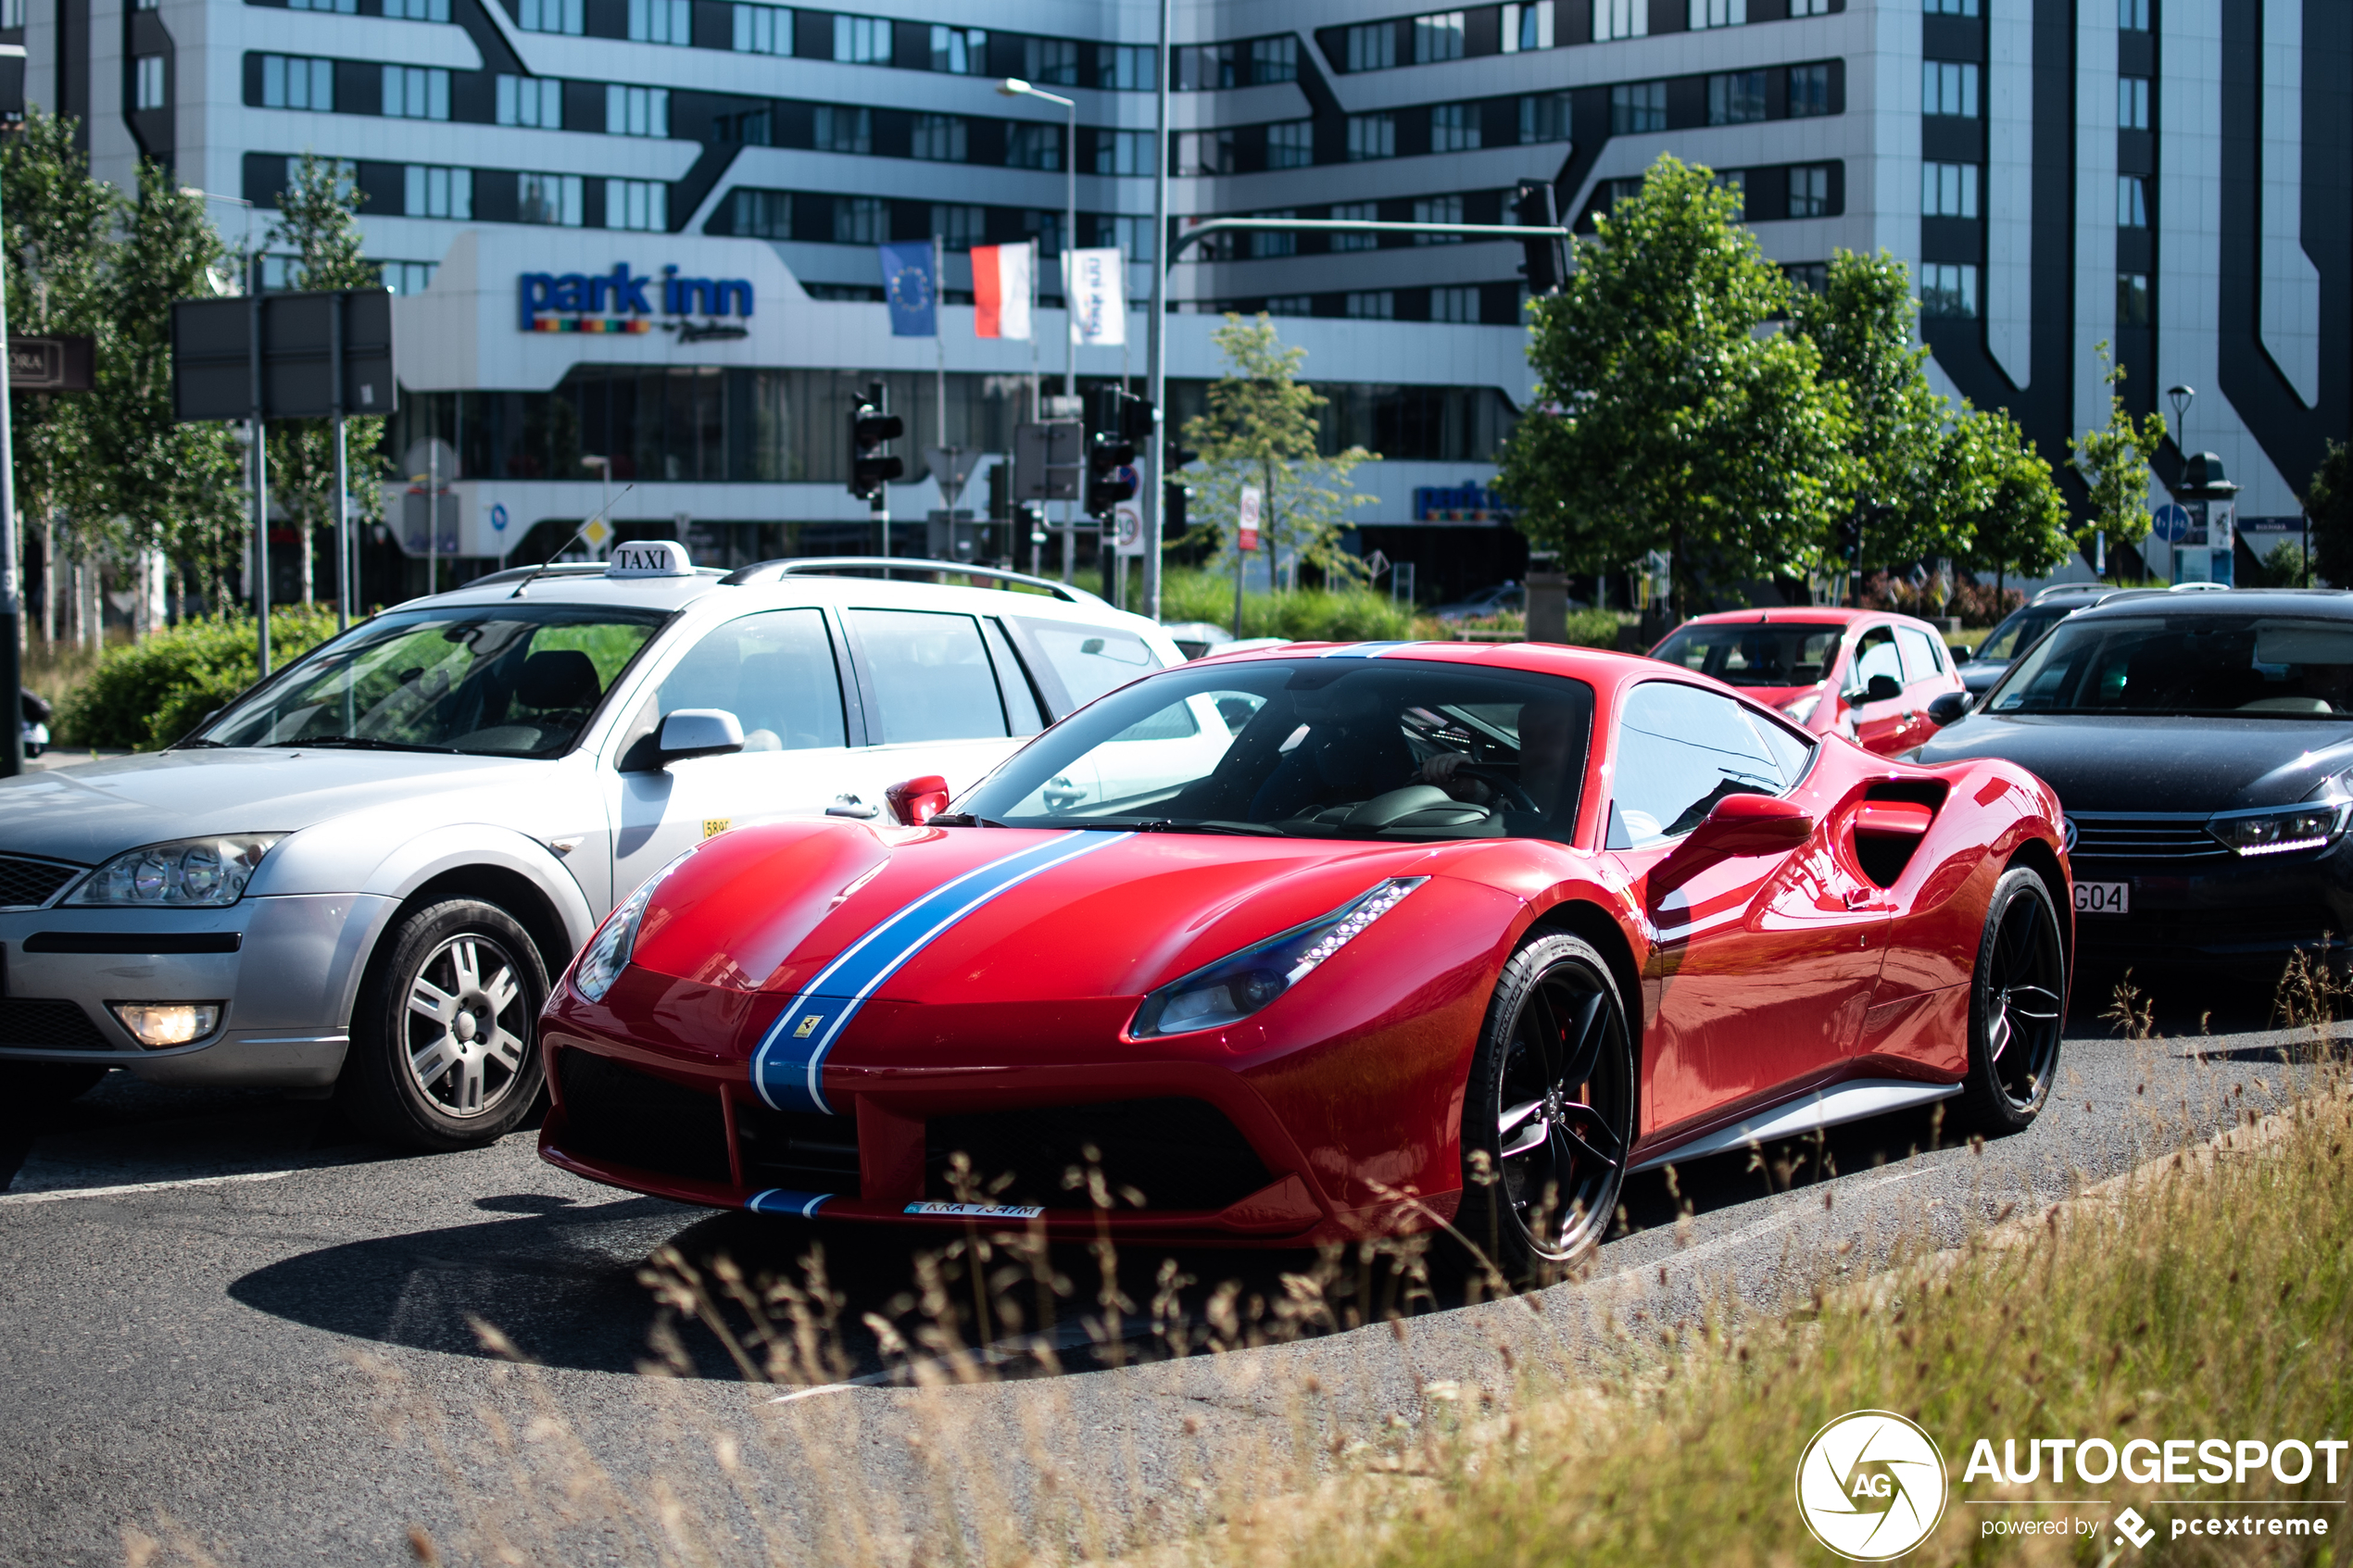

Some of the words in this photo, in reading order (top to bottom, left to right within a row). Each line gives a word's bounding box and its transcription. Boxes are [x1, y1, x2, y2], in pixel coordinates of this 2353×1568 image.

[518, 263, 652, 332] park
[663, 264, 754, 317] inn
[617, 549, 666, 570] TAXI
[1498, 985, 1520, 1046] MICHELIN
[926, 1202, 965, 1211] KRA
